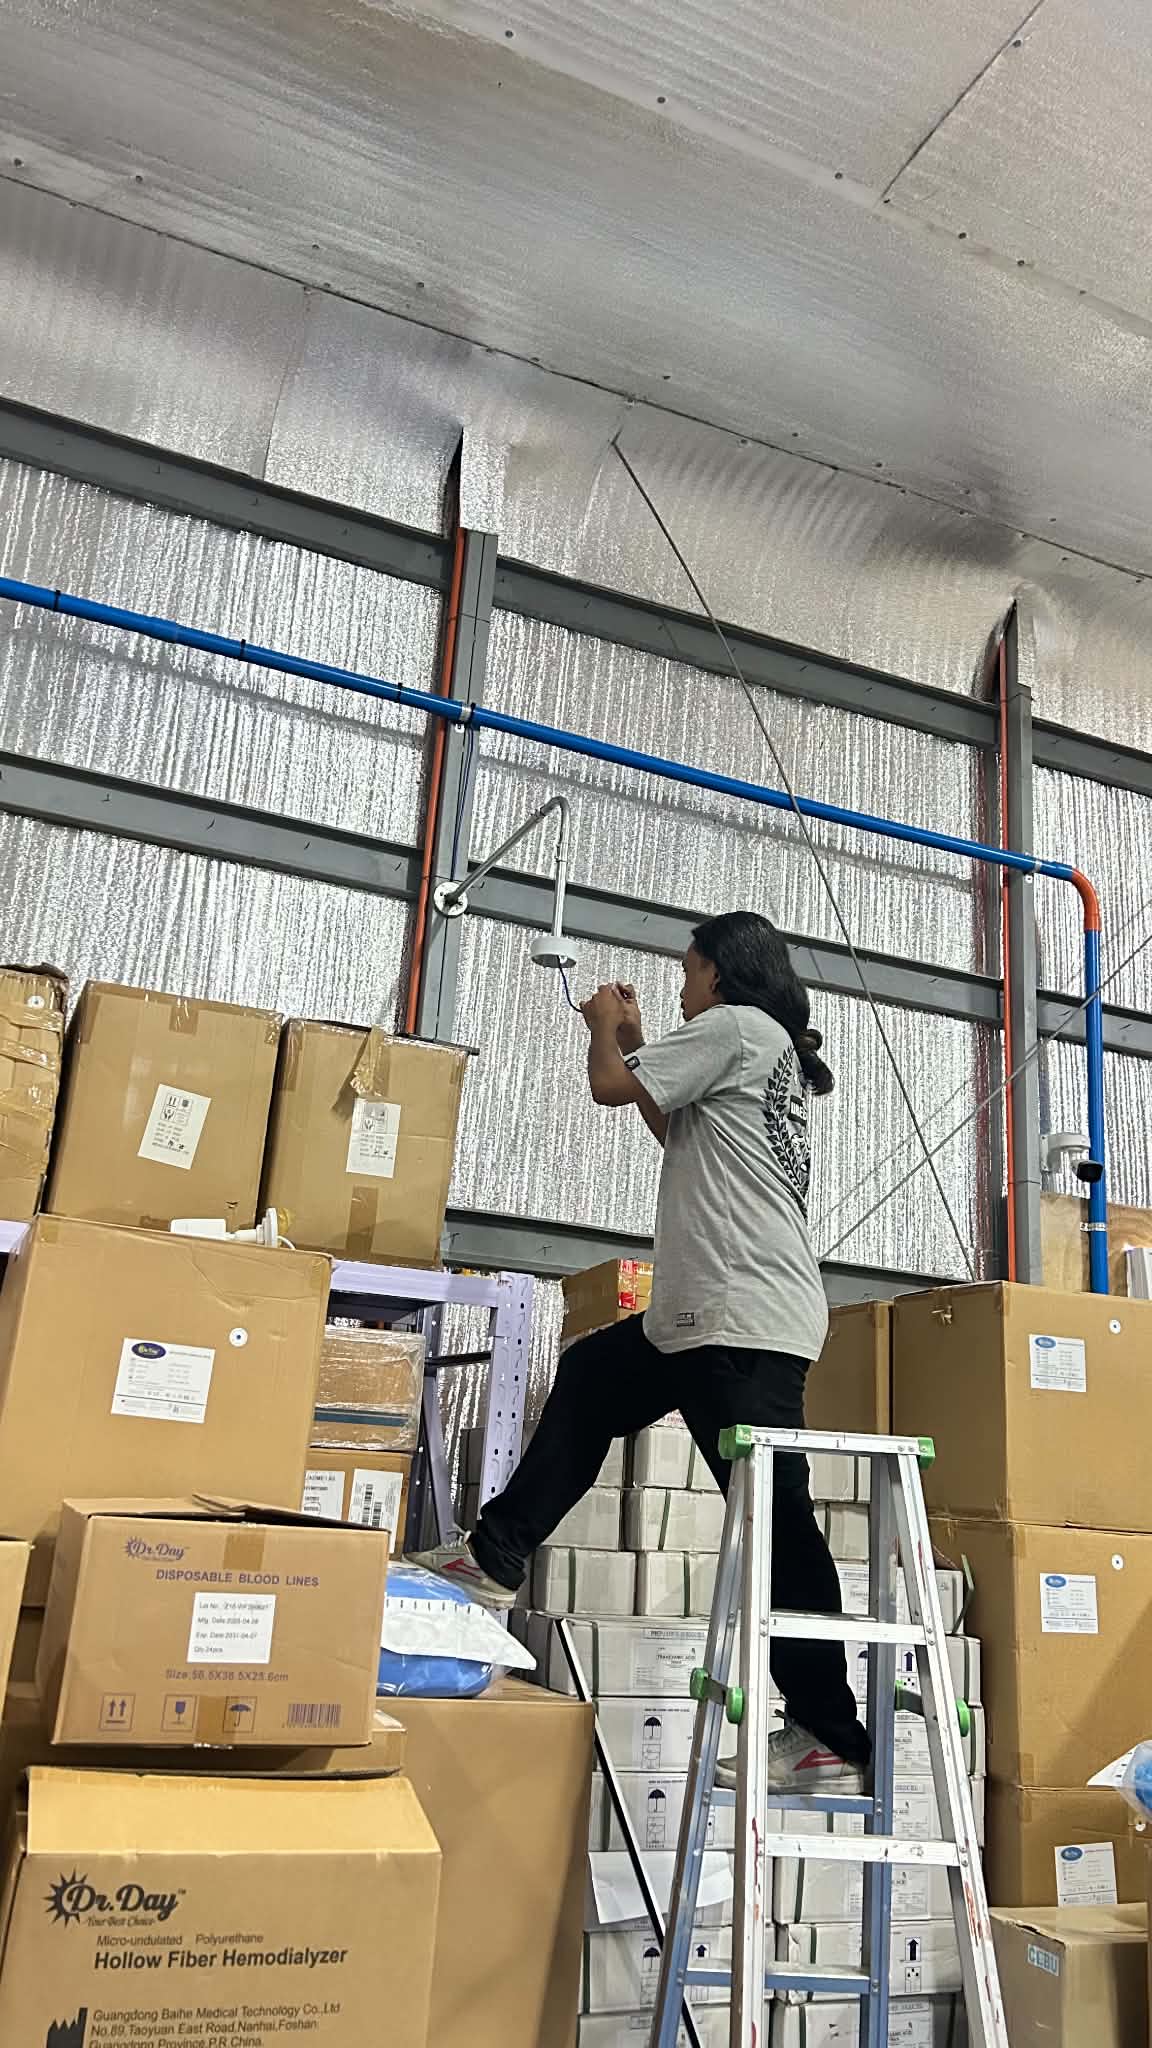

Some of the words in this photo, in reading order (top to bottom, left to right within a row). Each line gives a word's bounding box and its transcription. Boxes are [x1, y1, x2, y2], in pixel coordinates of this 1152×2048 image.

[156, 1568, 233, 1583] DISPOSABLE
[238, 1573, 280, 1585] BLOOD
[286, 1575, 320, 1587] LINES
[66, 1884, 179, 1922] Dr.Day
[96, 1935, 183, 1946] Micro-undulated
[195, 1932, 264, 1946] Polyurethane
[94, 1951, 162, 1969] Hollow
[167, 1950, 217, 1968] Fiber
[222, 1947, 349, 1968] Hemodialyzer
[93, 2009, 159, 2023] Guangdong
[161, 2008, 193, 2020] Baihe
[196, 2006, 238, 2019] Medical
[240, 2005, 301, 2018] Technology
[177, 2022, 203, 2034] East
